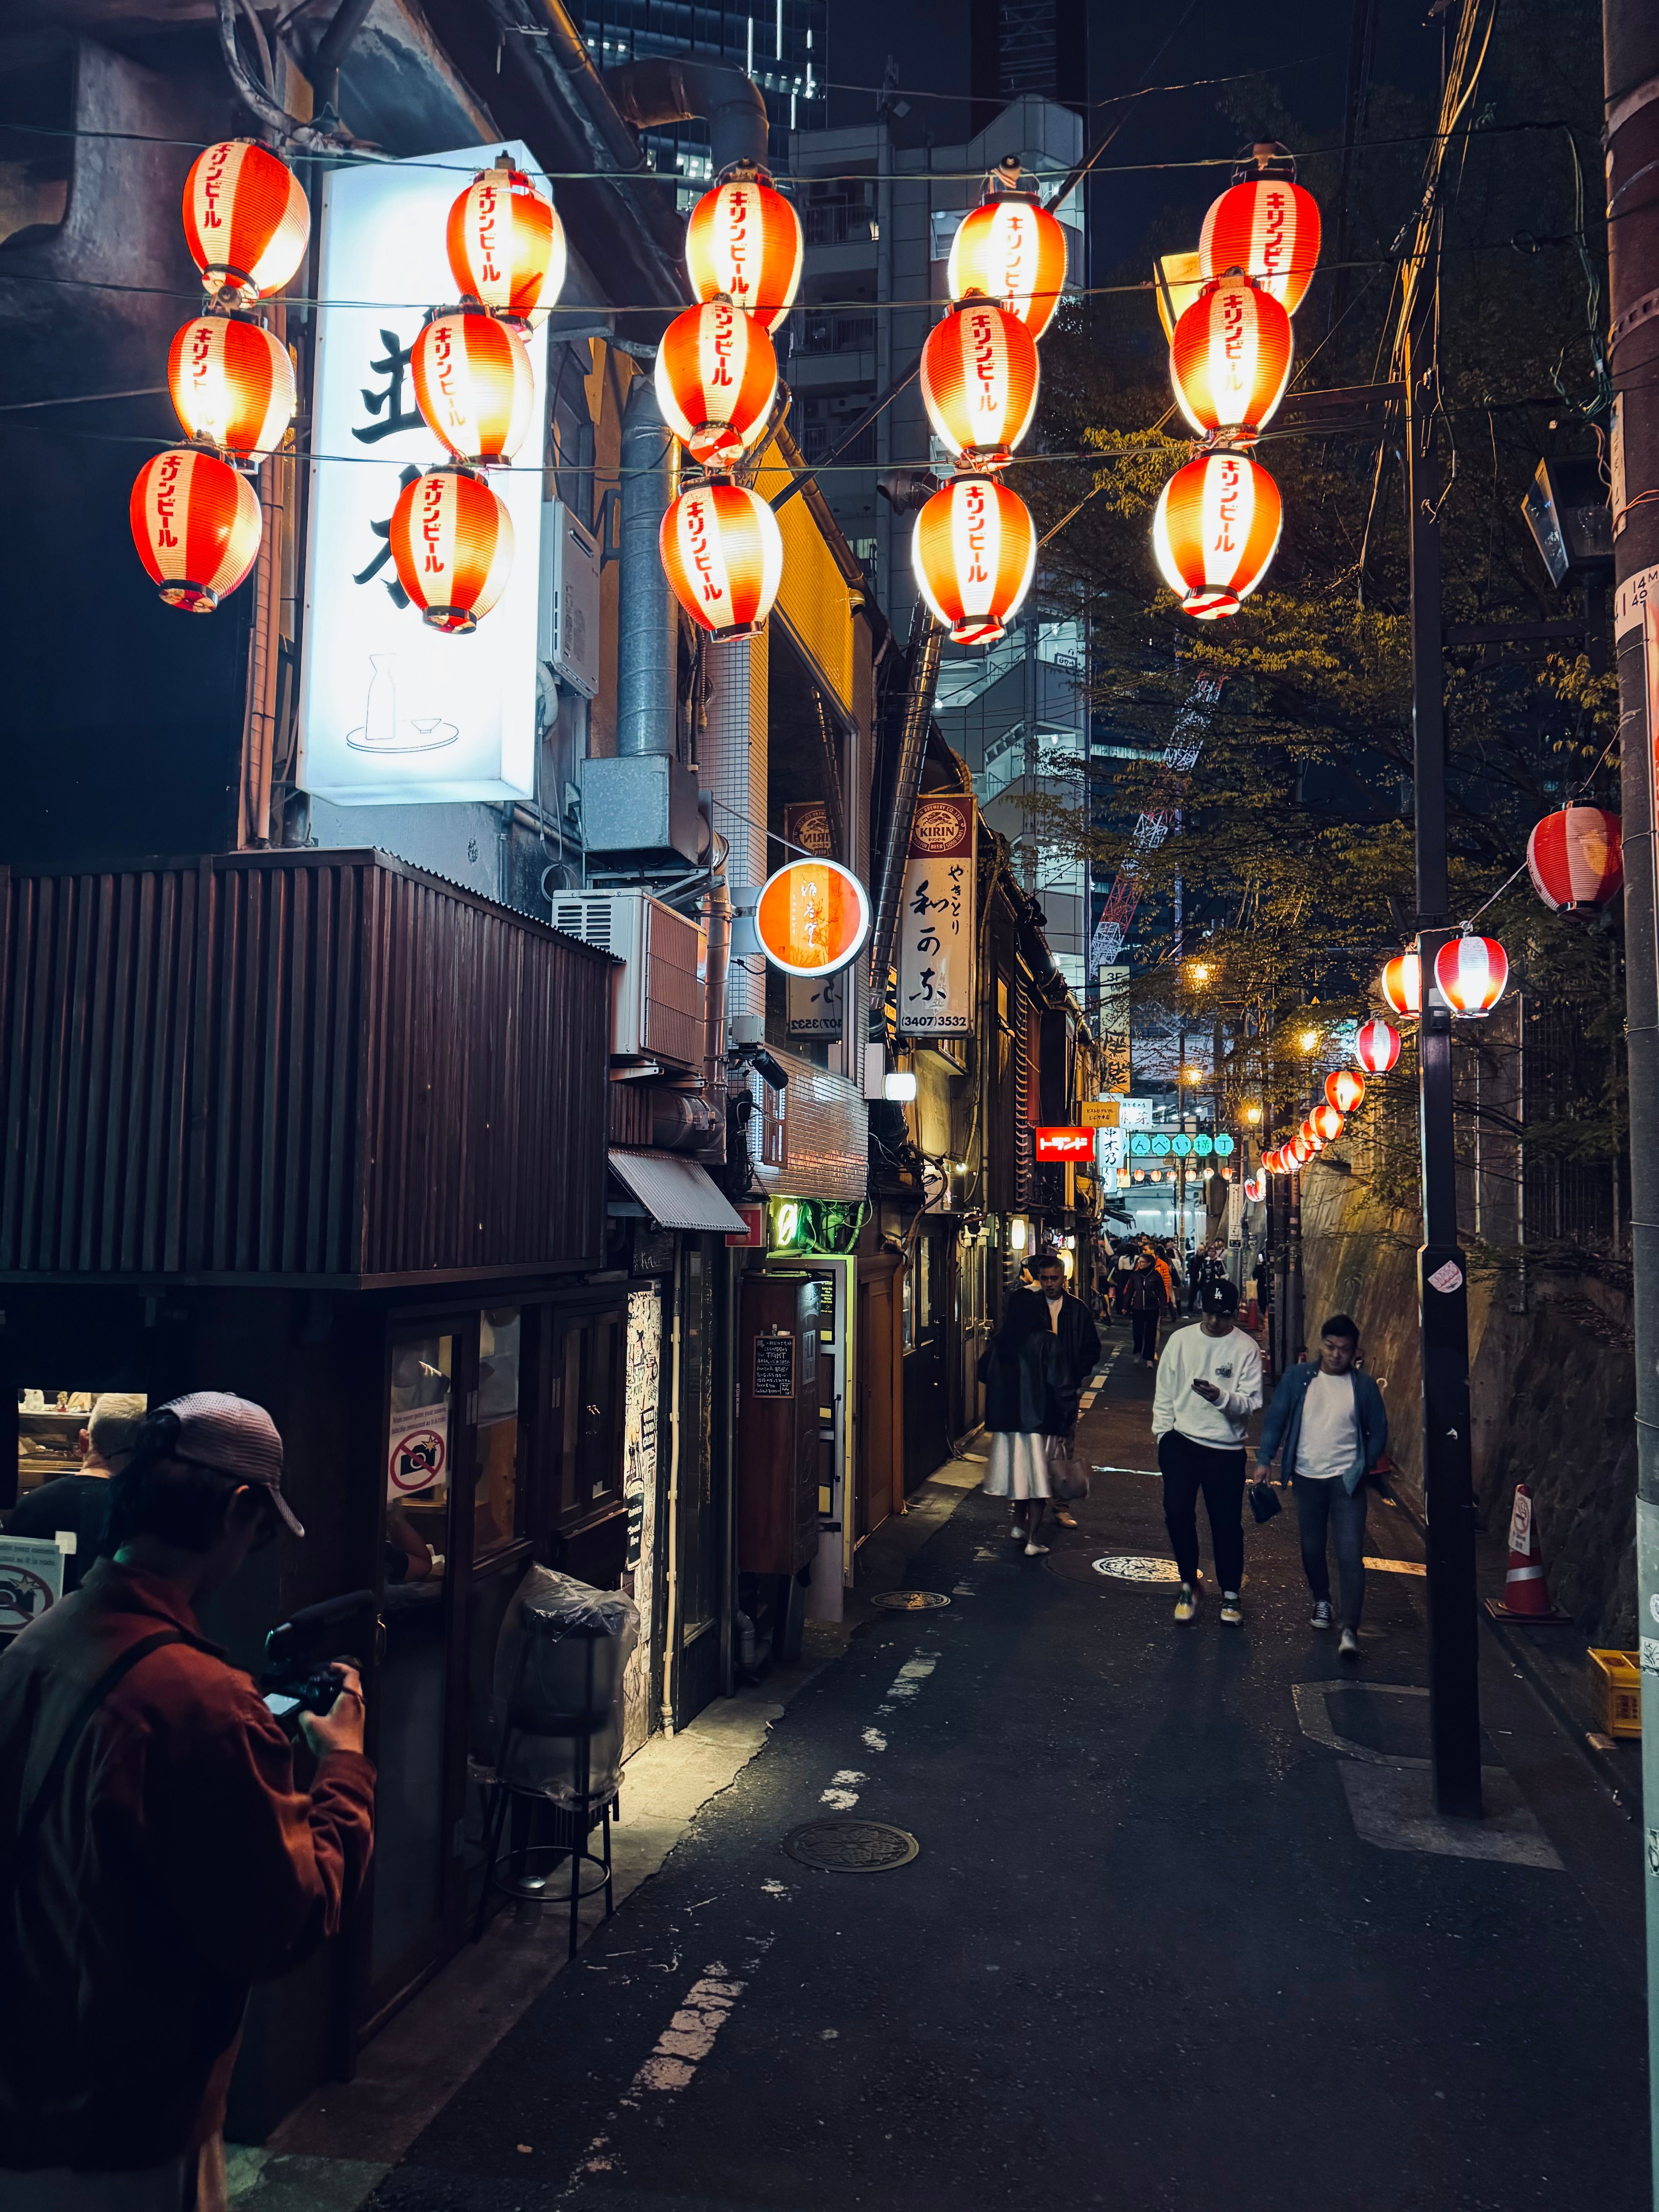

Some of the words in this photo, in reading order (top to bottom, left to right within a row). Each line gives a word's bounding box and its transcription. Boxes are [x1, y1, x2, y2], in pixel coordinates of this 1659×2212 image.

[203, 143, 235, 229] キリンビール
[479, 187, 501, 282] キリンビール
[728, 190, 750, 295] キリンビール
[192, 329, 216, 426] キリンル
[434, 326, 467, 428] キリンビール
[711, 305, 735, 388] キリンビール
[970, 314, 999, 413] キリンビール
[1222, 293, 1244, 391] キリンビール
[157, 455, 184, 548] キリンビール
[423, 479, 446, 573] キリンビール
[965, 485, 989, 584] キリンビール
[1214, 460, 1239, 554] キリンビール
[686, 500, 723, 603] キリンビール
[920, 827, 954, 837] KIRIN
[946, 839, 957, 848] GOOD
[948, 865, 963, 936] やきとり
[902, 1016, 967, 1027] (3407)3532
[1123, 1140, 1230, 1151] んべい横丁
[1214, 1288, 1223, 1300] LA
[644, 1410, 654, 1422] WITH
